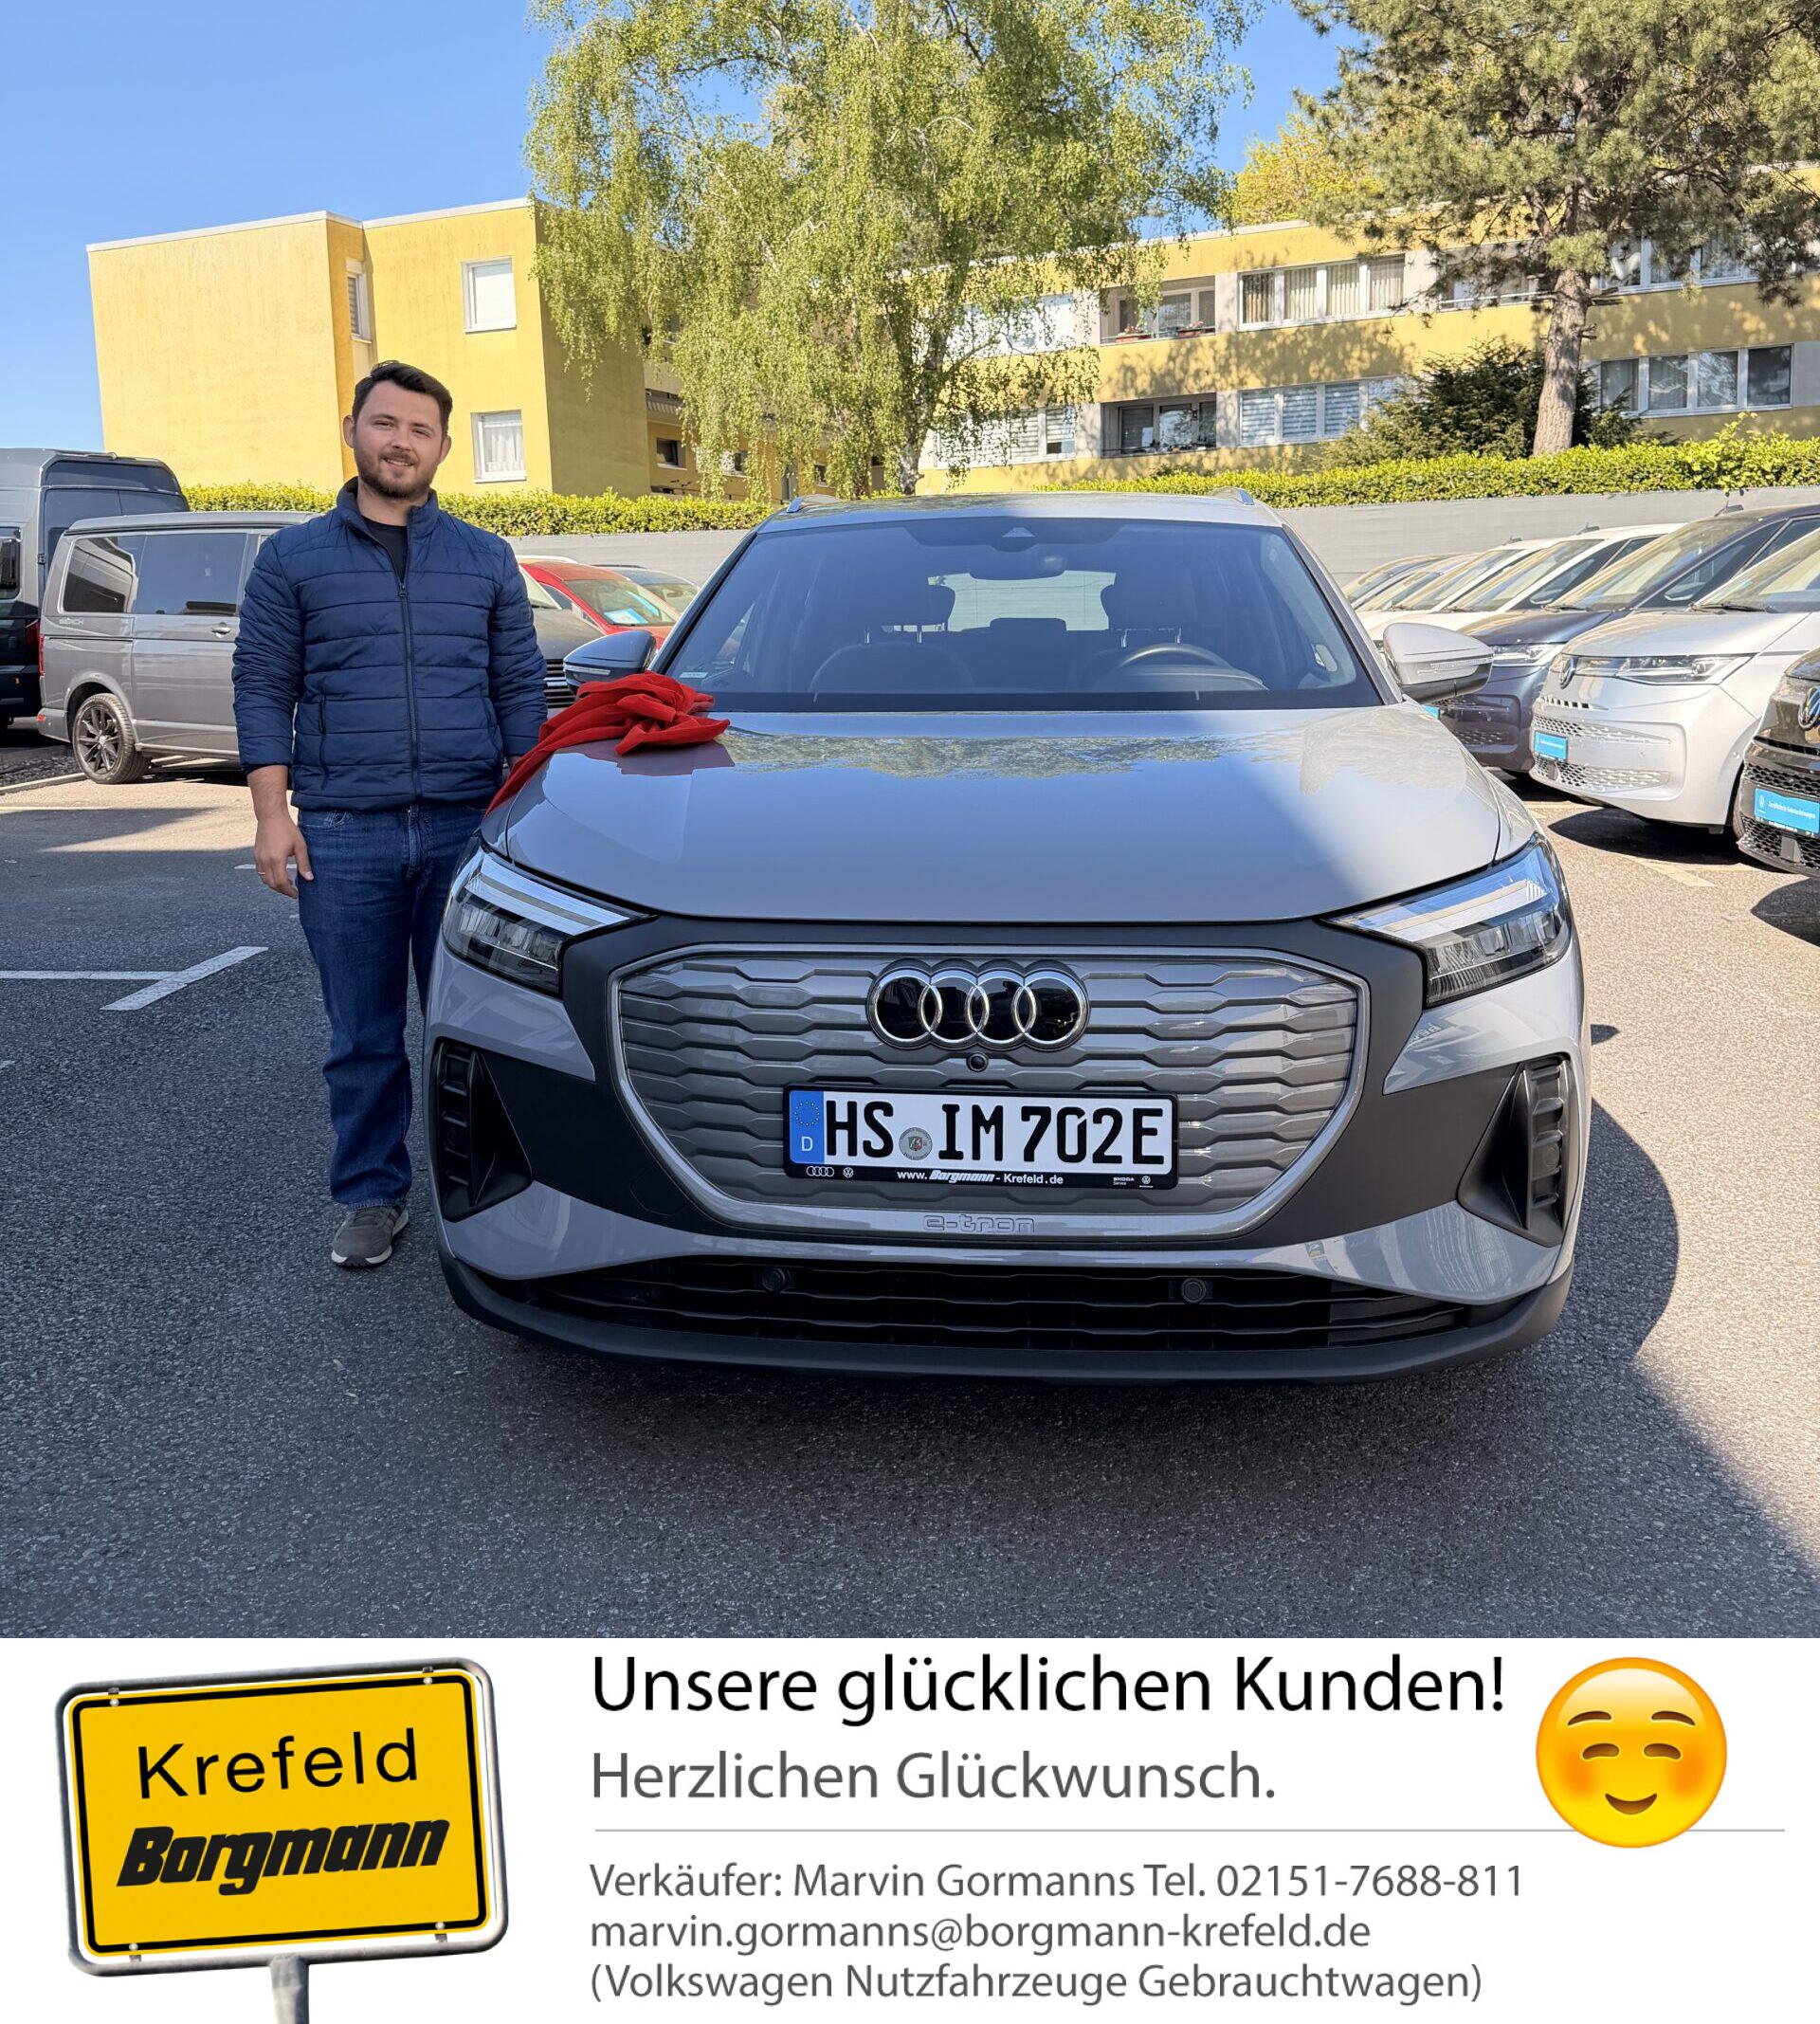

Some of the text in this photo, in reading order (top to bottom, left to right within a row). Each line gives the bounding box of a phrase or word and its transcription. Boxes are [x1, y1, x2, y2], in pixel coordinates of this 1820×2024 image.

[826, 1100, 894, 1158] HS
[937, 1103, 1004, 1161] IM
[1020, 1105, 1165, 1165] 702E
[801, 1136, 813, 1152] D
[923, 1213, 1035, 1233] e-tron
